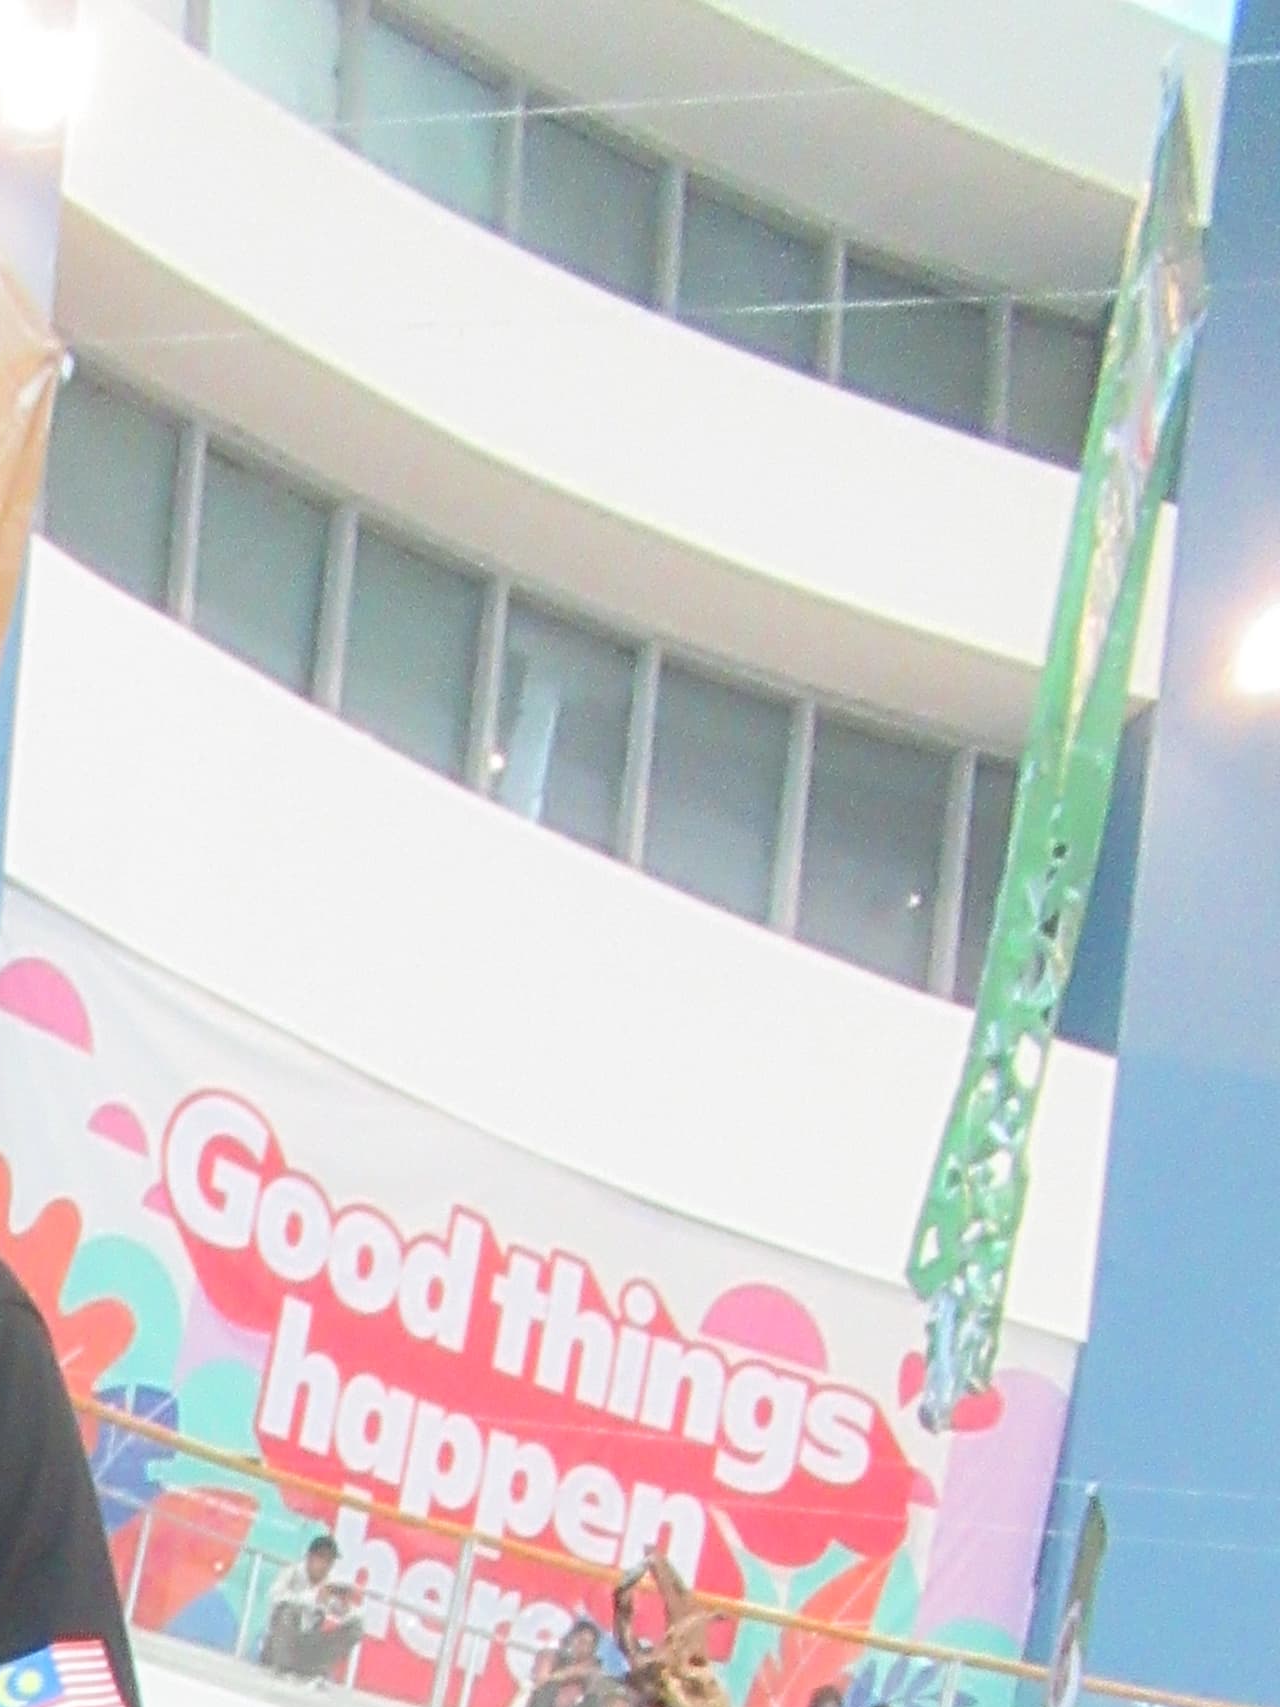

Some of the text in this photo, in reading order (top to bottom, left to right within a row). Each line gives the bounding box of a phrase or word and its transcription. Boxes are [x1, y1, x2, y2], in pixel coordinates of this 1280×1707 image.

[164, 1092, 876, 1494] Good things
[258, 1297, 706, 1590] happen
